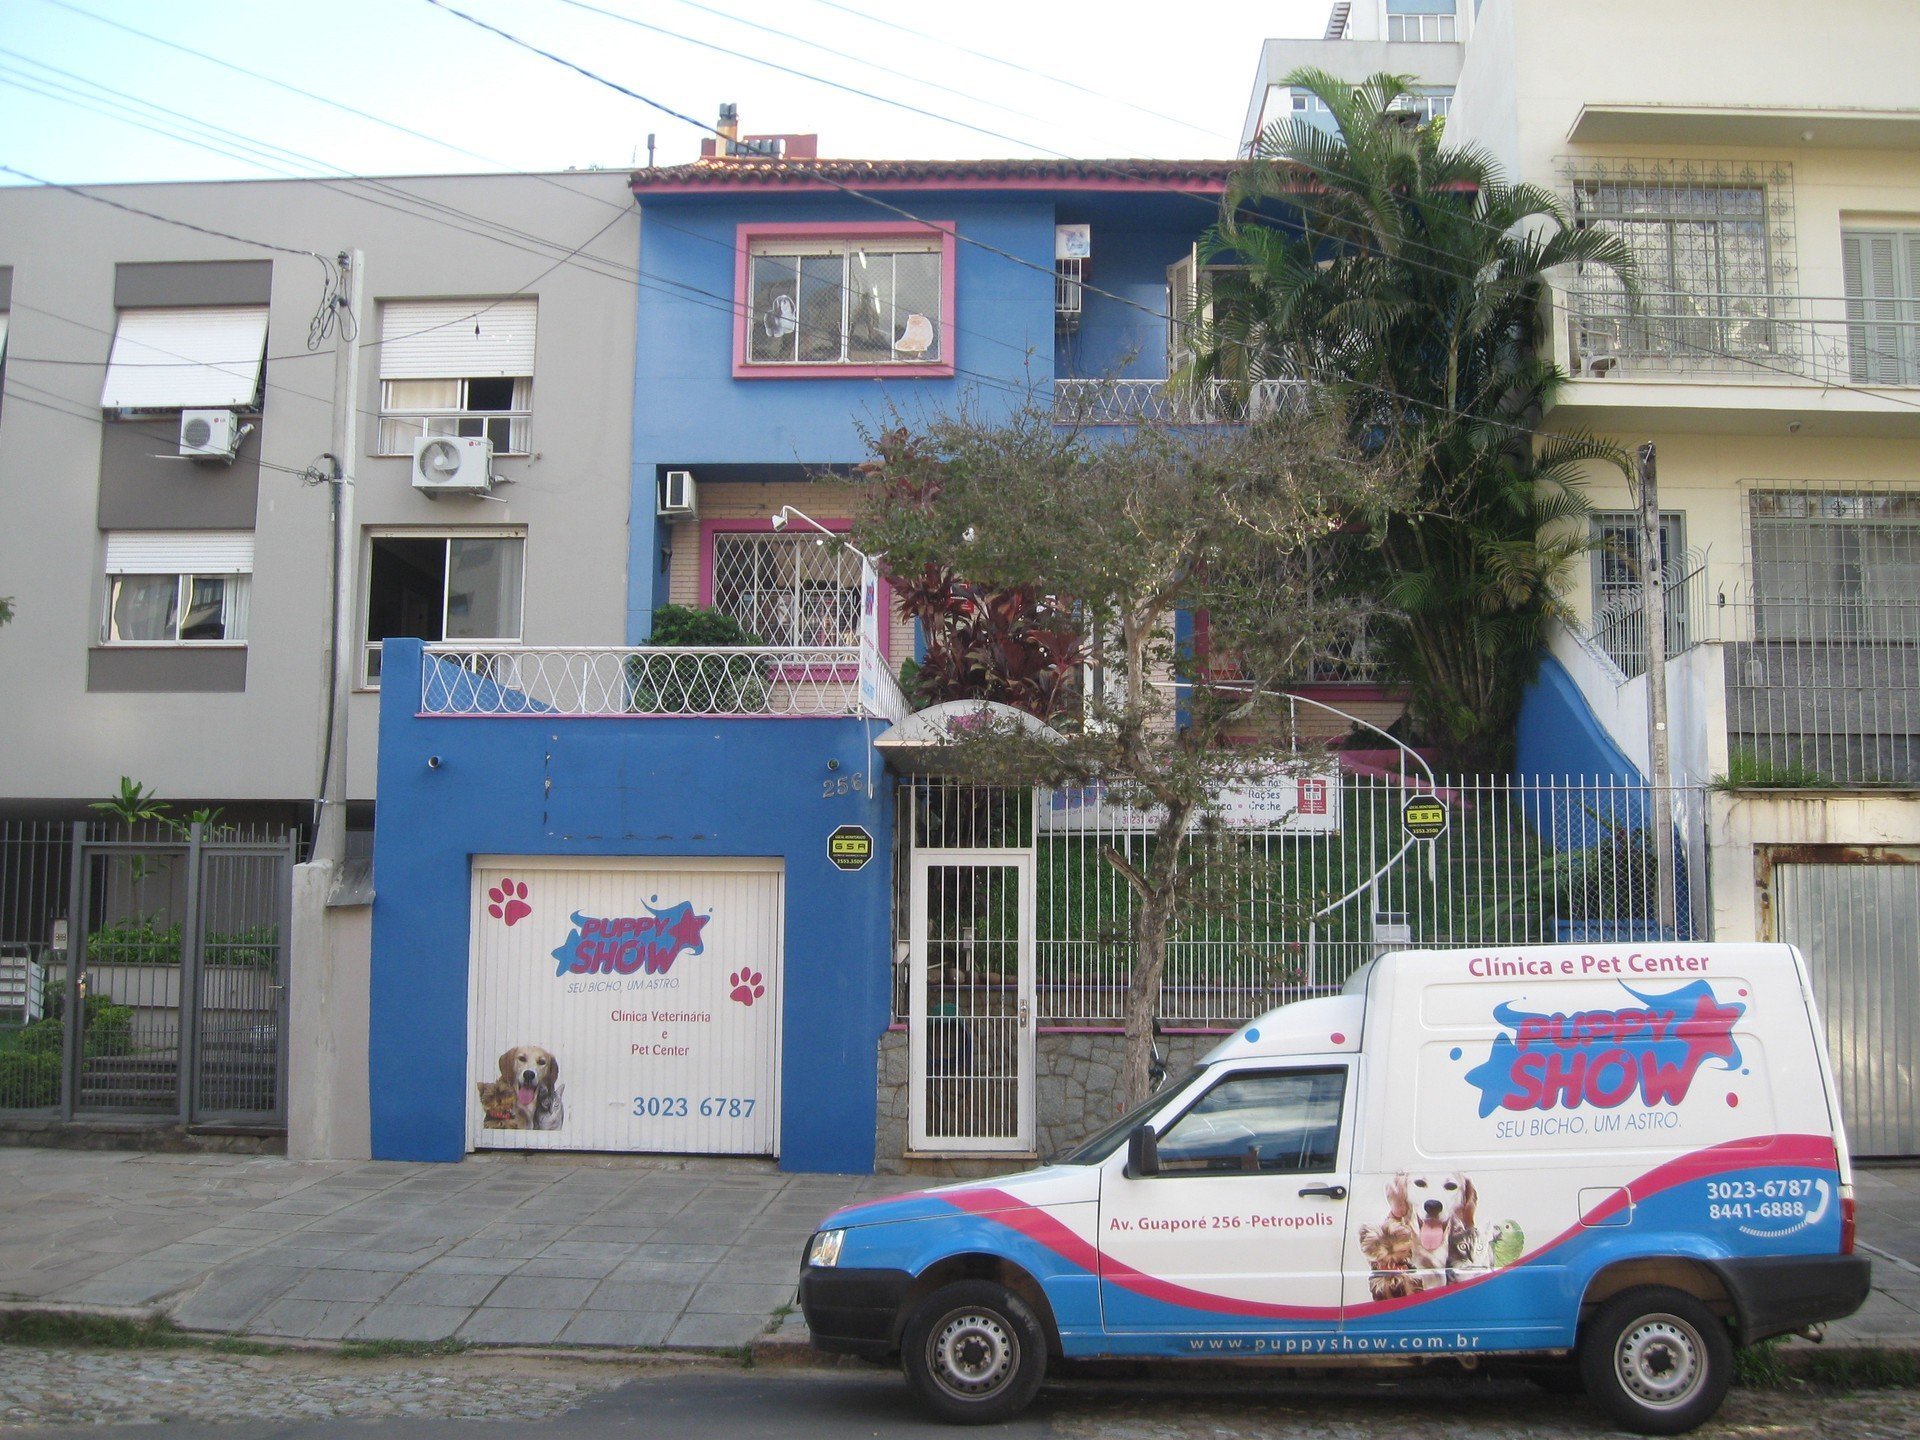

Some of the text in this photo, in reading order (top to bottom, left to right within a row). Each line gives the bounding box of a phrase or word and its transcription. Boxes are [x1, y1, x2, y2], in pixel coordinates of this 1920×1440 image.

[823, 772, 863, 798] 256
[581, 917, 670, 938] PUPPY
[570, 939, 680, 974] SHOW
[1468, 953, 1710, 977] Clínica e Pet Center
[568, 978, 680, 994] SEU BICHO, UM ASTRO.
[611, 1010, 711, 1022] Clínica Veterinária
[661, 1030, 668, 1039] e
[1516, 1009, 1675, 1052] PUPPY
[631, 1044, 689, 1056] Pet Center
[1502, 1049, 1695, 1111] SHOW
[633, 1096, 756, 1118] 3023 6787
[1495, 1111, 1682, 1138] SEU BICHO, UM ASTRO.
[1706, 1179, 1812, 1200] 3023-6787
[1709, 1201, 1804, 1219] 8441-6888
[1110, 1217, 1134, 1230] Av.
[1138, 1216, 1207, 1232] Guaporé
[1212, 1216, 1241, 1229] 256
[1190, 1334, 1480, 1352] www.puppyshow.com.br
